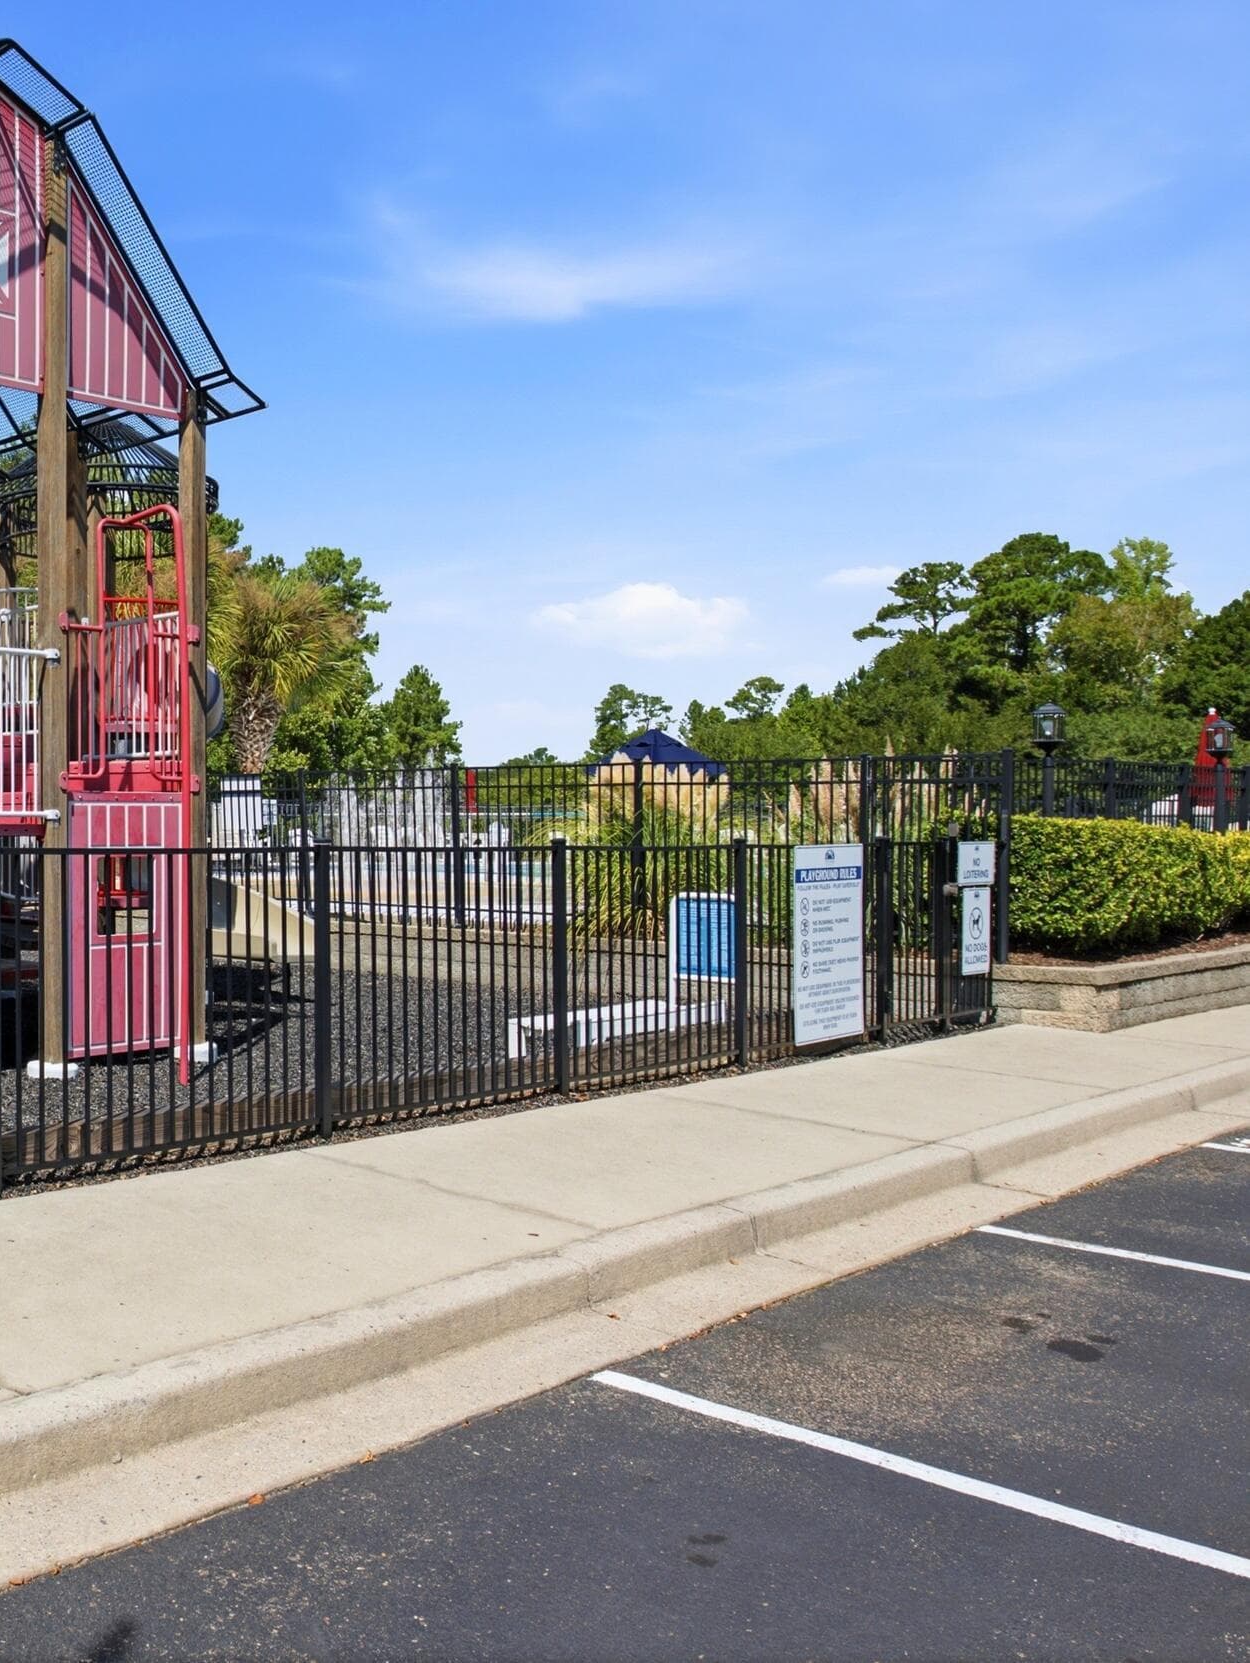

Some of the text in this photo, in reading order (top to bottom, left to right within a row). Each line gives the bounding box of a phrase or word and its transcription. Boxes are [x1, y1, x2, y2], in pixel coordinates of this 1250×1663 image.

[973, 858, 981, 866] NO
[801, 867, 857, 882] PLAYGROUND RULES
[963, 869, 989, 879] LOITERING
[965, 942, 988, 953] NO DOGS
[965, 955, 988, 965] ALLOWED
